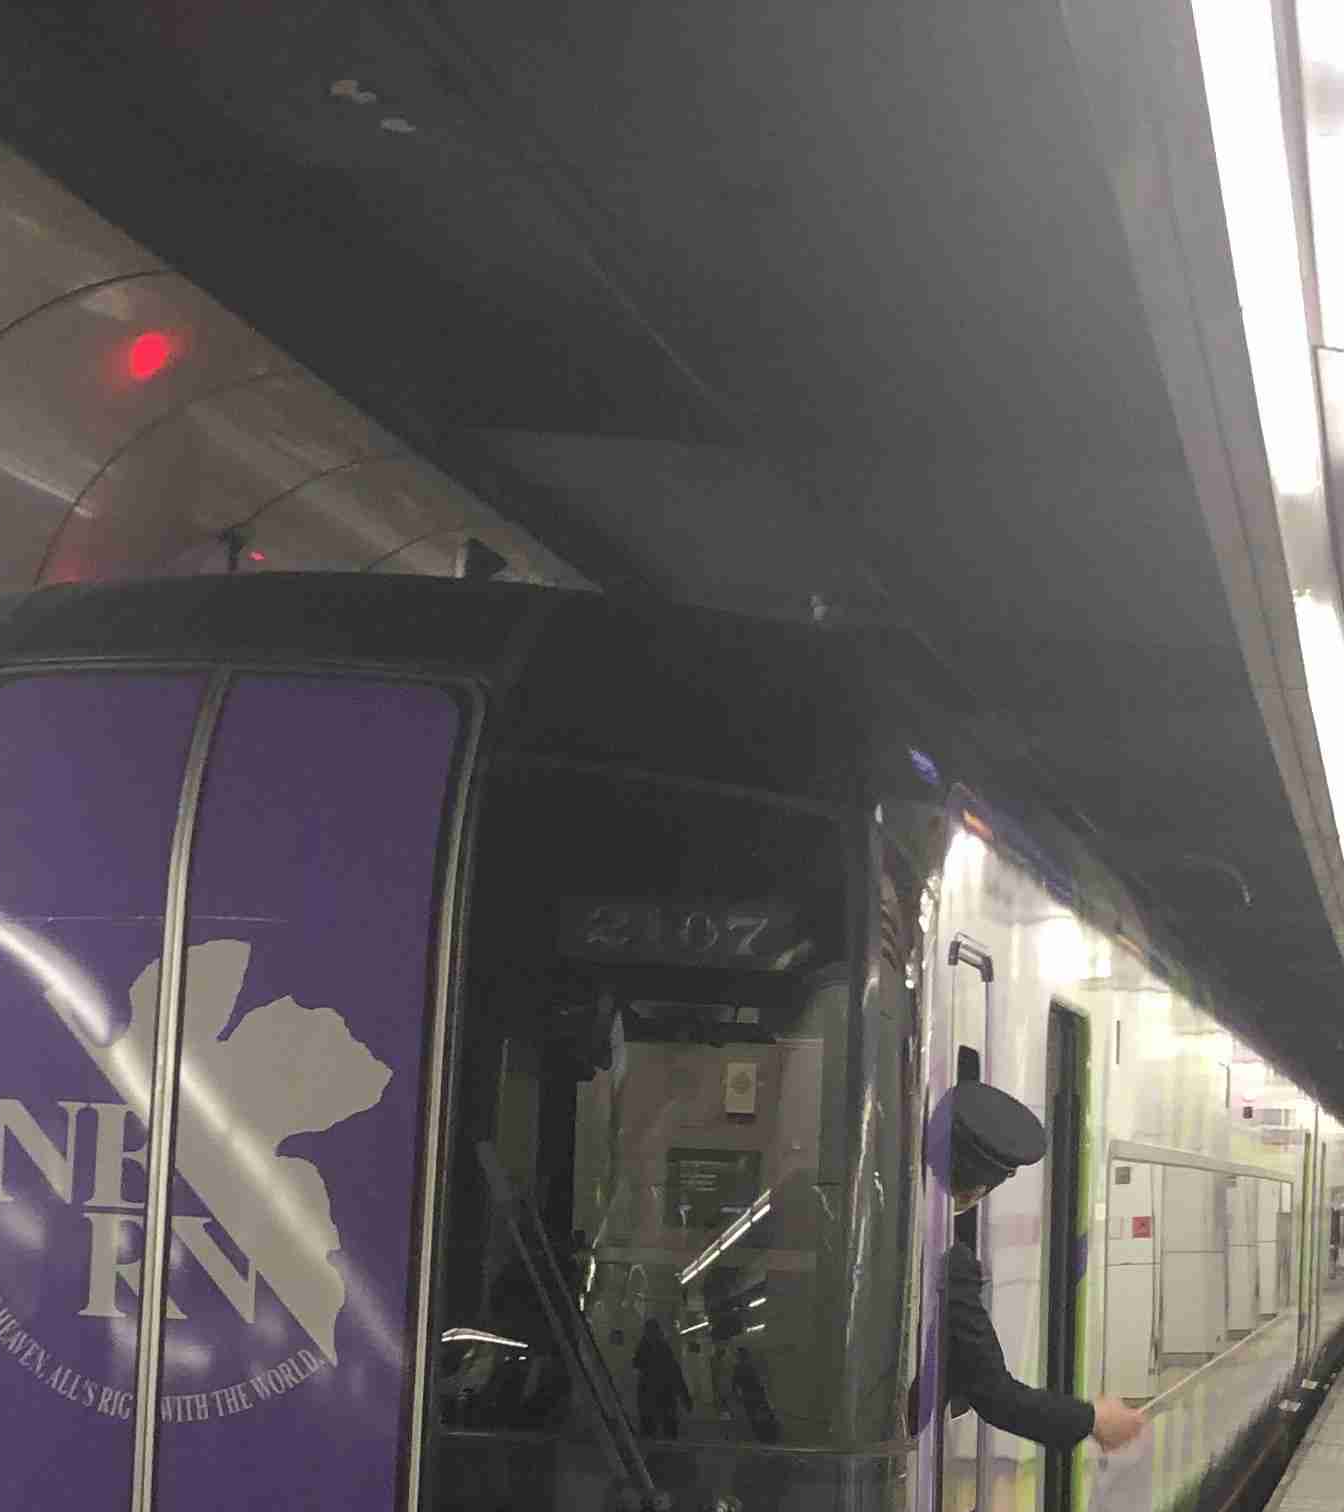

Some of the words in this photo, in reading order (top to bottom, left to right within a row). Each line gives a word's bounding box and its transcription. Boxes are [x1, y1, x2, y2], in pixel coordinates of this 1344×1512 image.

[46, 1364, 98, 1408] ALL'S
[160, 1392, 209, 1424] WITH
[211, 1382, 254, 1418] THE
